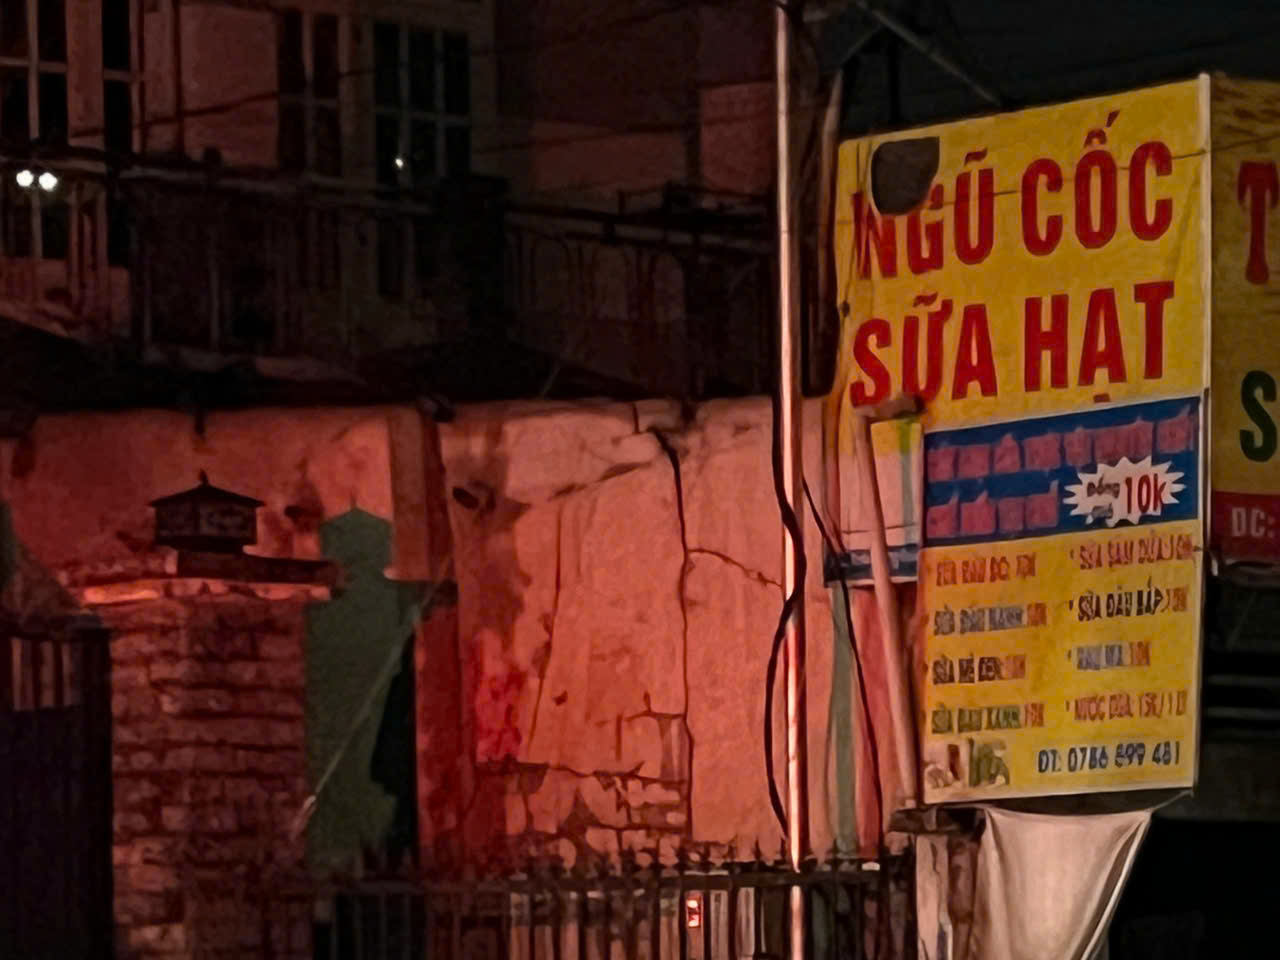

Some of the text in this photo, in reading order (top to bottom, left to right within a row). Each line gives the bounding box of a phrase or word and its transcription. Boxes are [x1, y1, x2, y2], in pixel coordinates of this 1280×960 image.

[850, 109, 1174, 280] NGŨ CỐC
[850, 280, 1175, 407] SỮA HẠT
